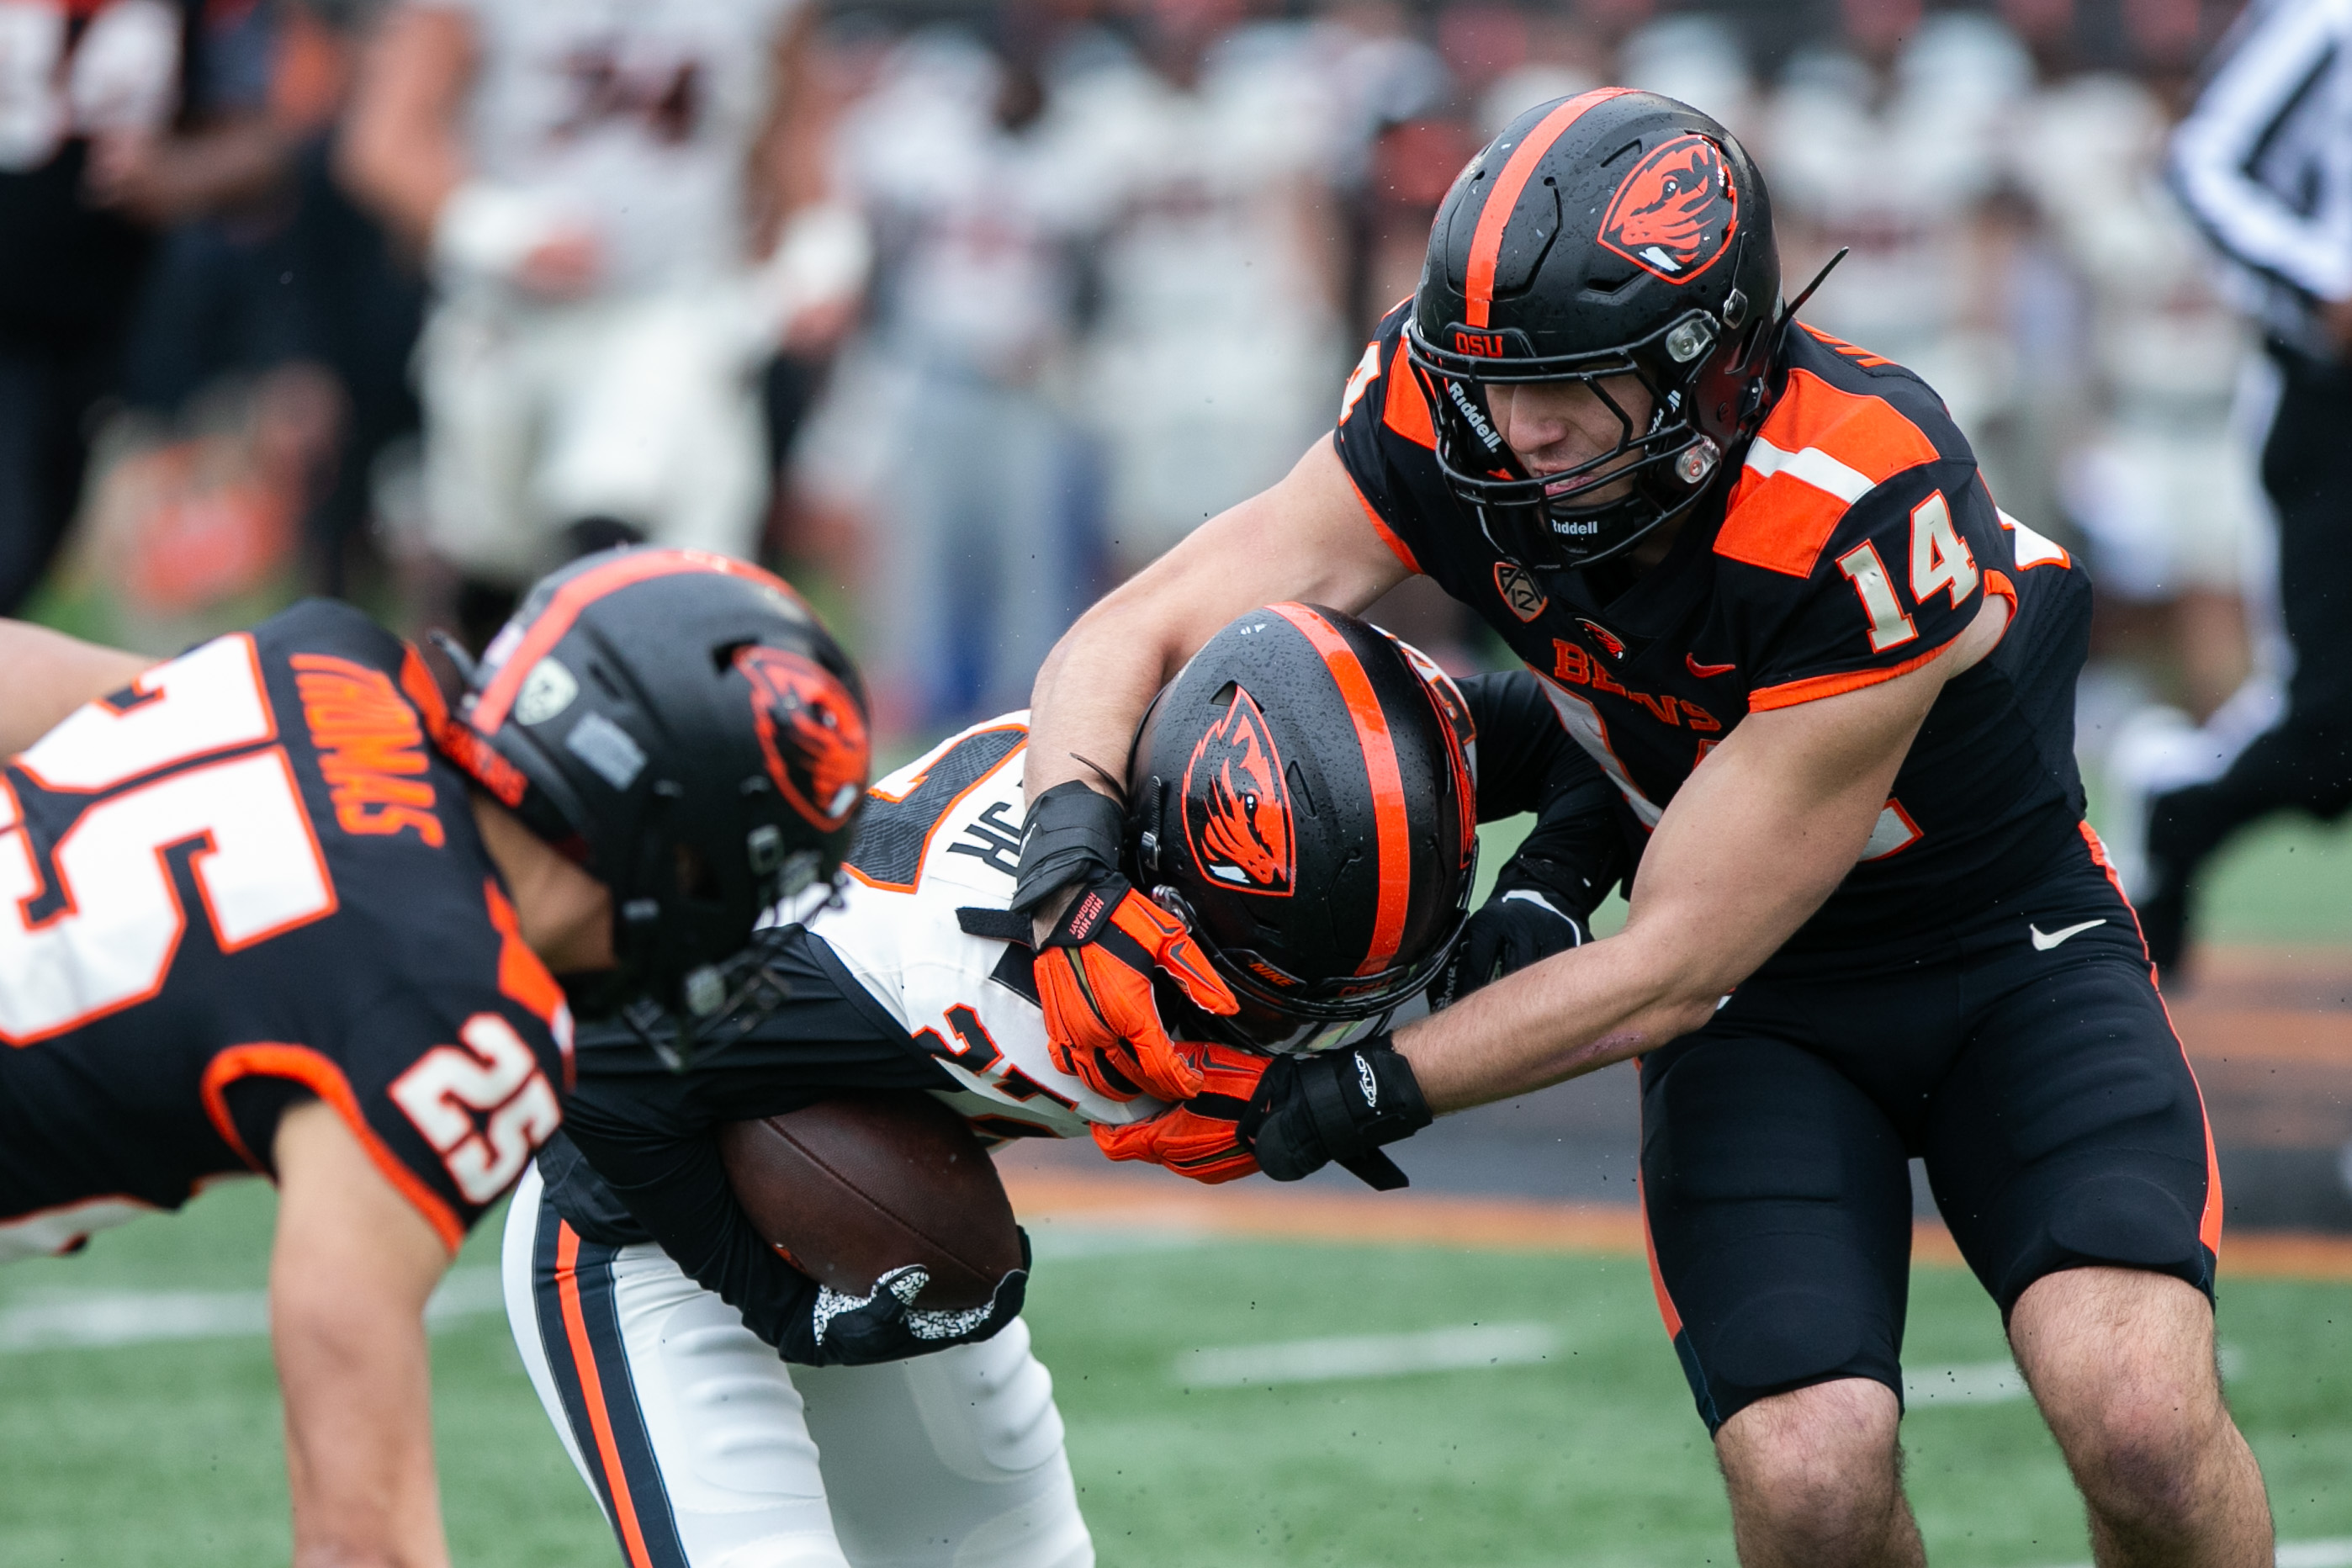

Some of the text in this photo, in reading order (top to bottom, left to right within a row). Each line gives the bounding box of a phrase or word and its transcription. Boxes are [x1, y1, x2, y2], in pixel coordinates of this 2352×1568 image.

[1455, 331, 1503, 358] OSU
[1449, 381, 1503, 453] Riddell
[1511, 587, 1536, 612] 12
[1835, 489, 1979, 654] 14
[289, 652, 446, 850] THOMAS
[1077, 896, 1104, 940] HIP HIP
[1249, 962, 1296, 988] NIKE
[387, 1011, 562, 1206] 25
